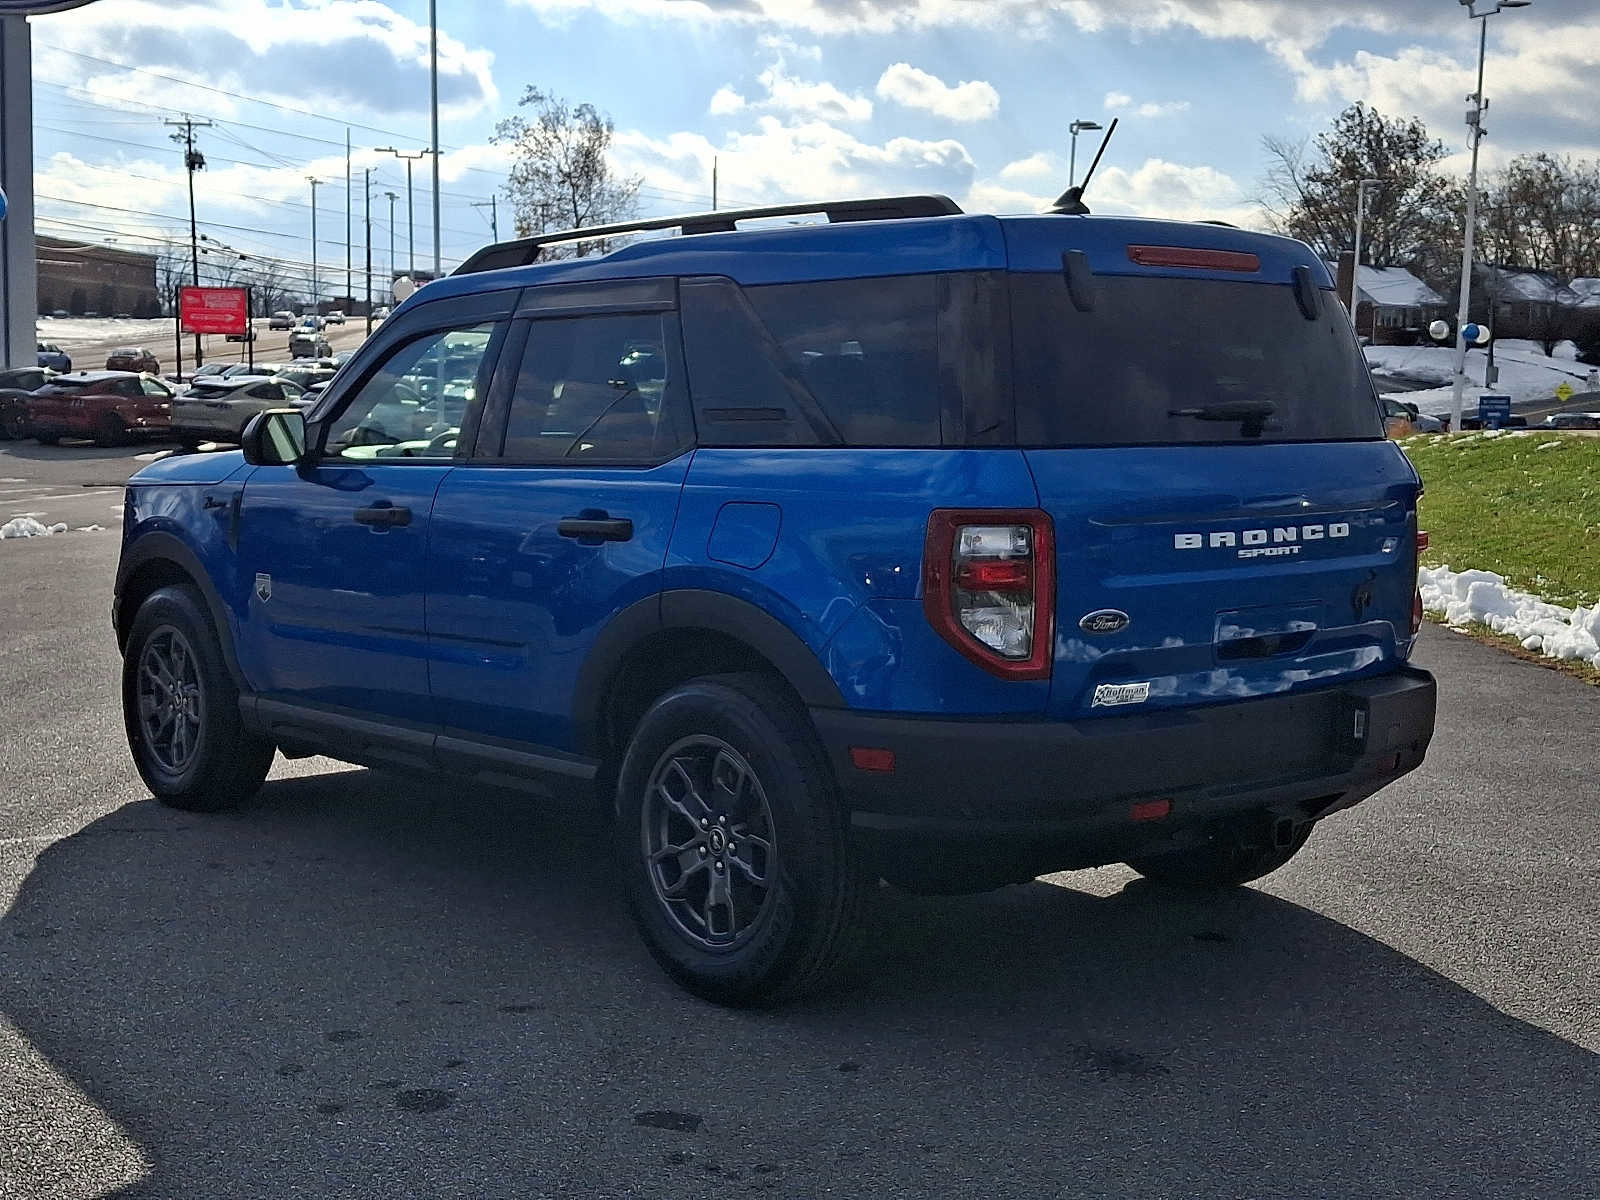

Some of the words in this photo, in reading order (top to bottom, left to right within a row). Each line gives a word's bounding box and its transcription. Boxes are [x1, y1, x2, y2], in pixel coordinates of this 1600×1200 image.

[1174, 522, 1350, 549] BRONCO
[1237, 545, 1302, 558] SPORT
[1092, 614, 1120, 630] Ford
